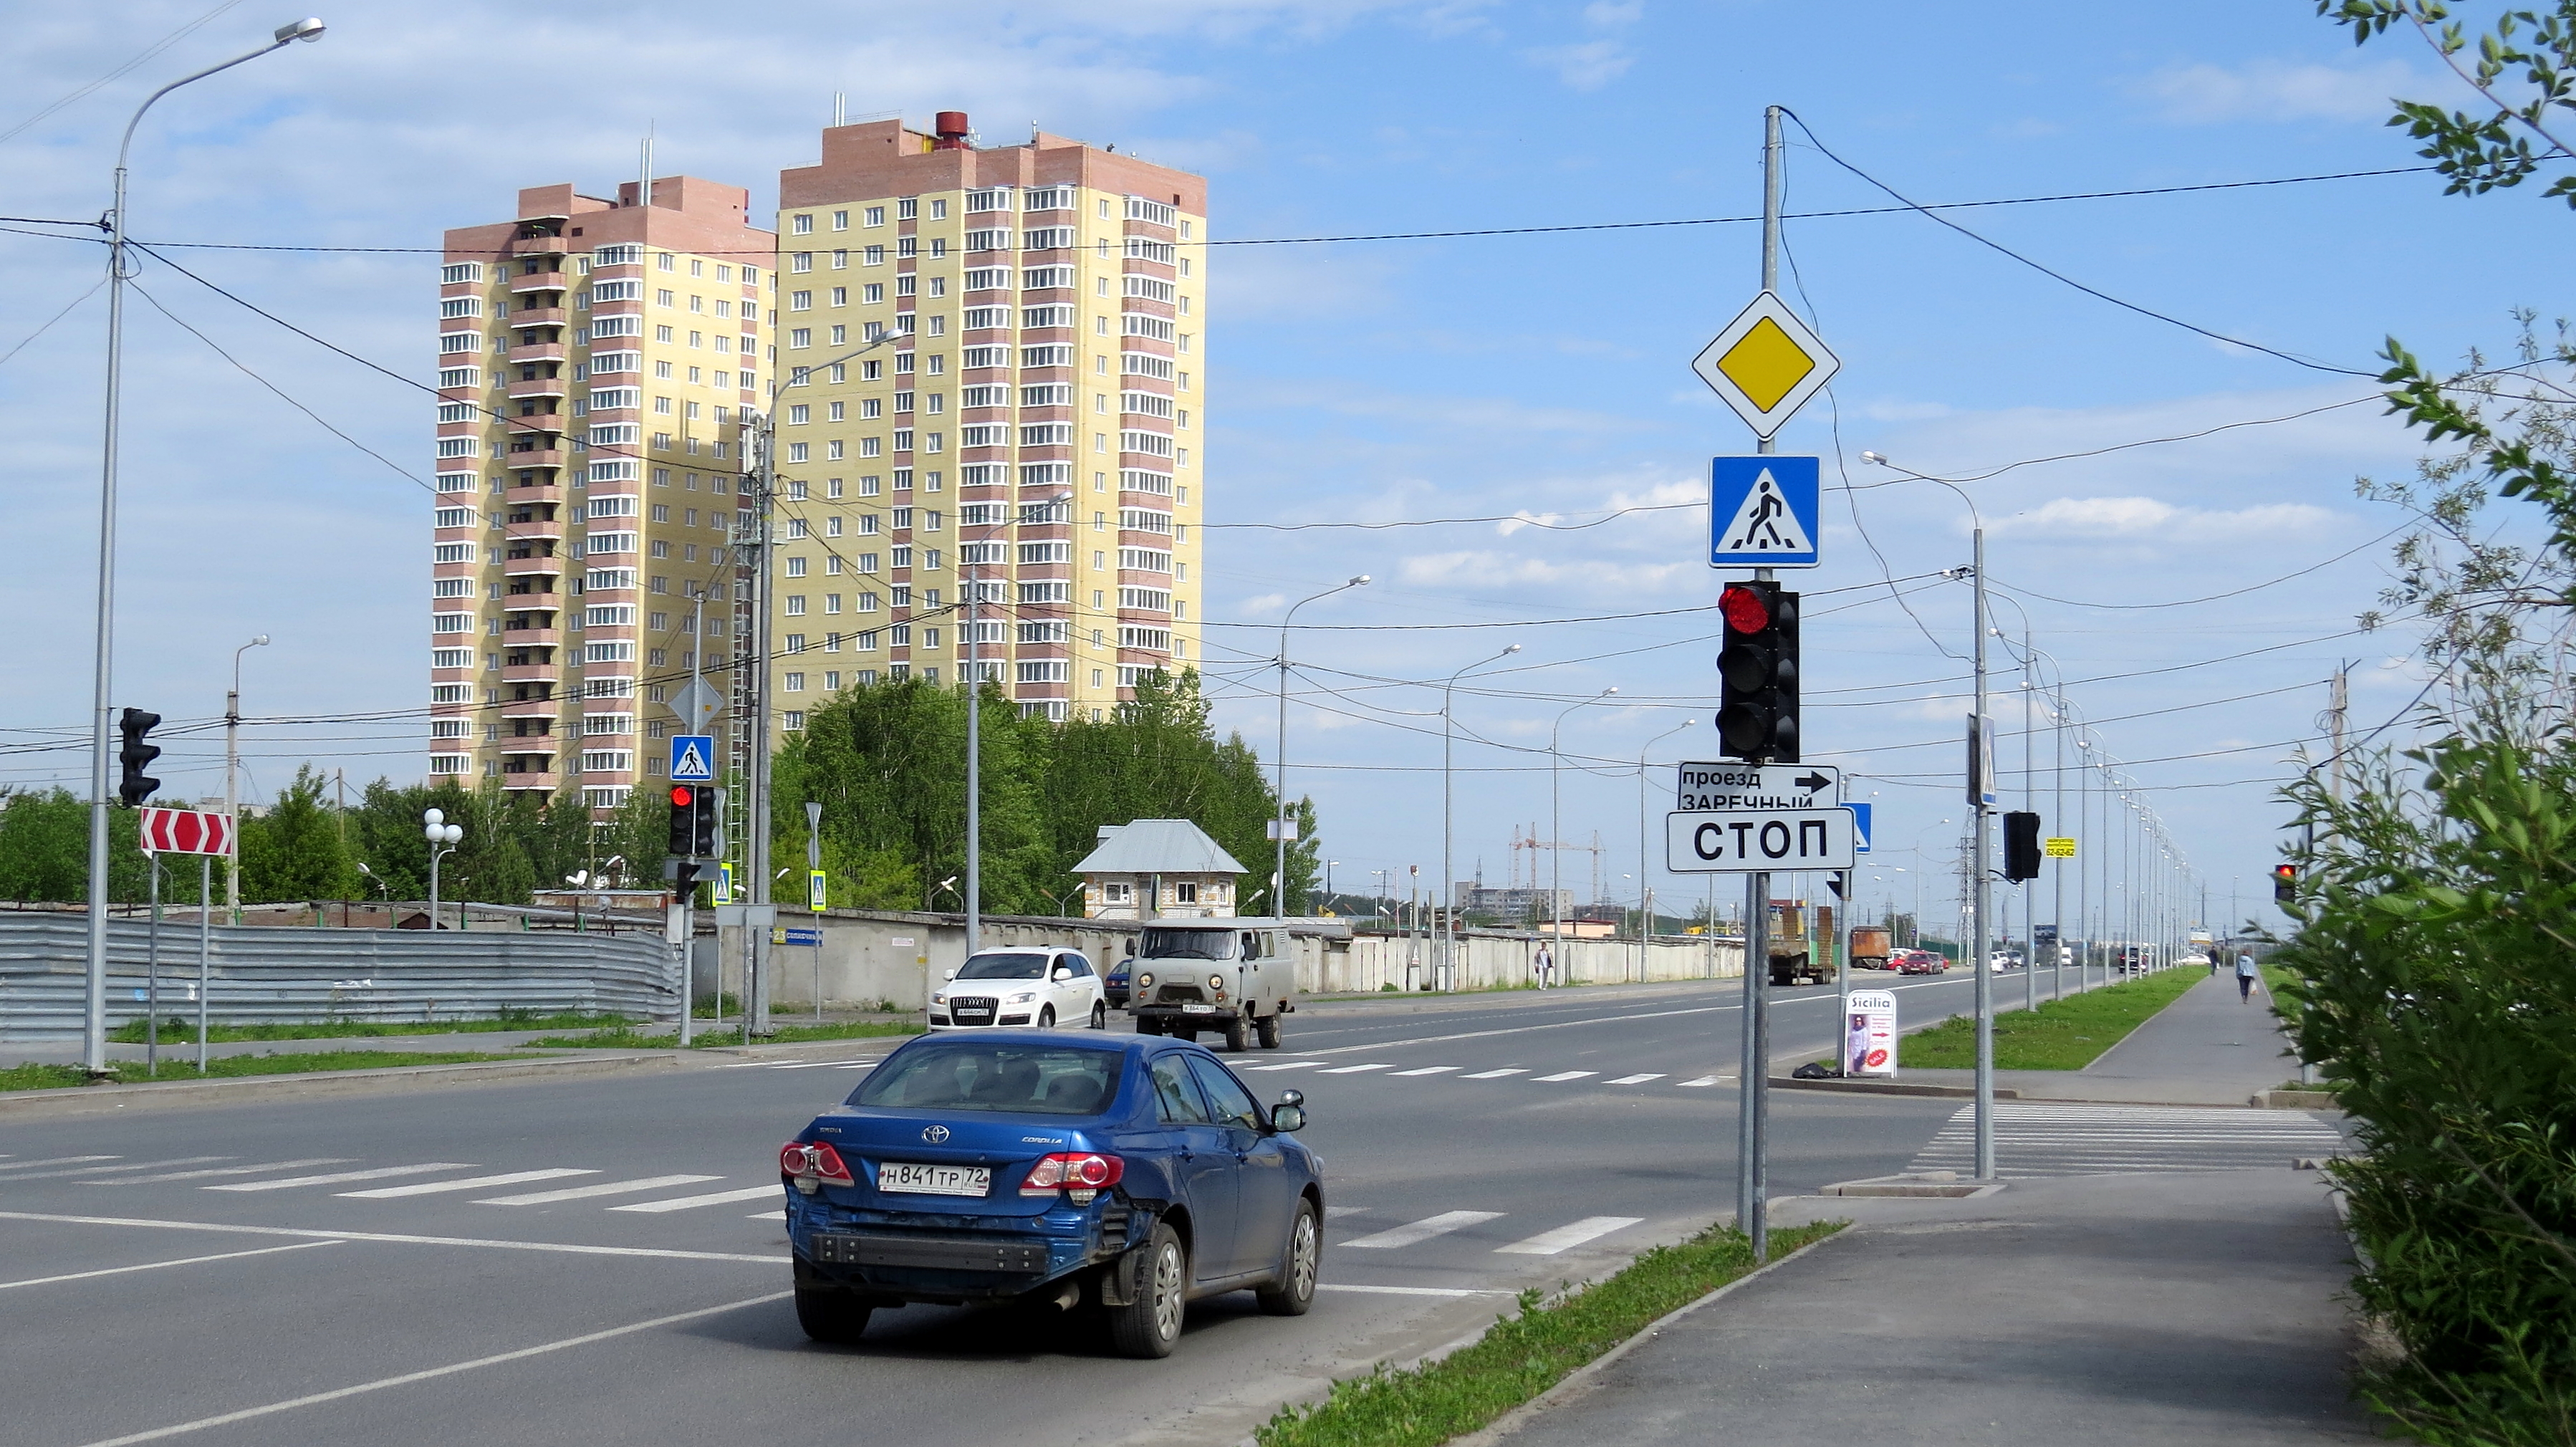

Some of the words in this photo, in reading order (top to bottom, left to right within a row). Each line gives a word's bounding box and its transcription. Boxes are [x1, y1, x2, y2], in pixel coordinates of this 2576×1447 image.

[1683, 771, 1762, 789] проезд
[1693, 819, 1827, 861] СТОП
[774, 931, 786, 941] 23
[1852, 996, 1890, 1008] Sicilia
[1869, 1052, 1885, 1064] SALE
